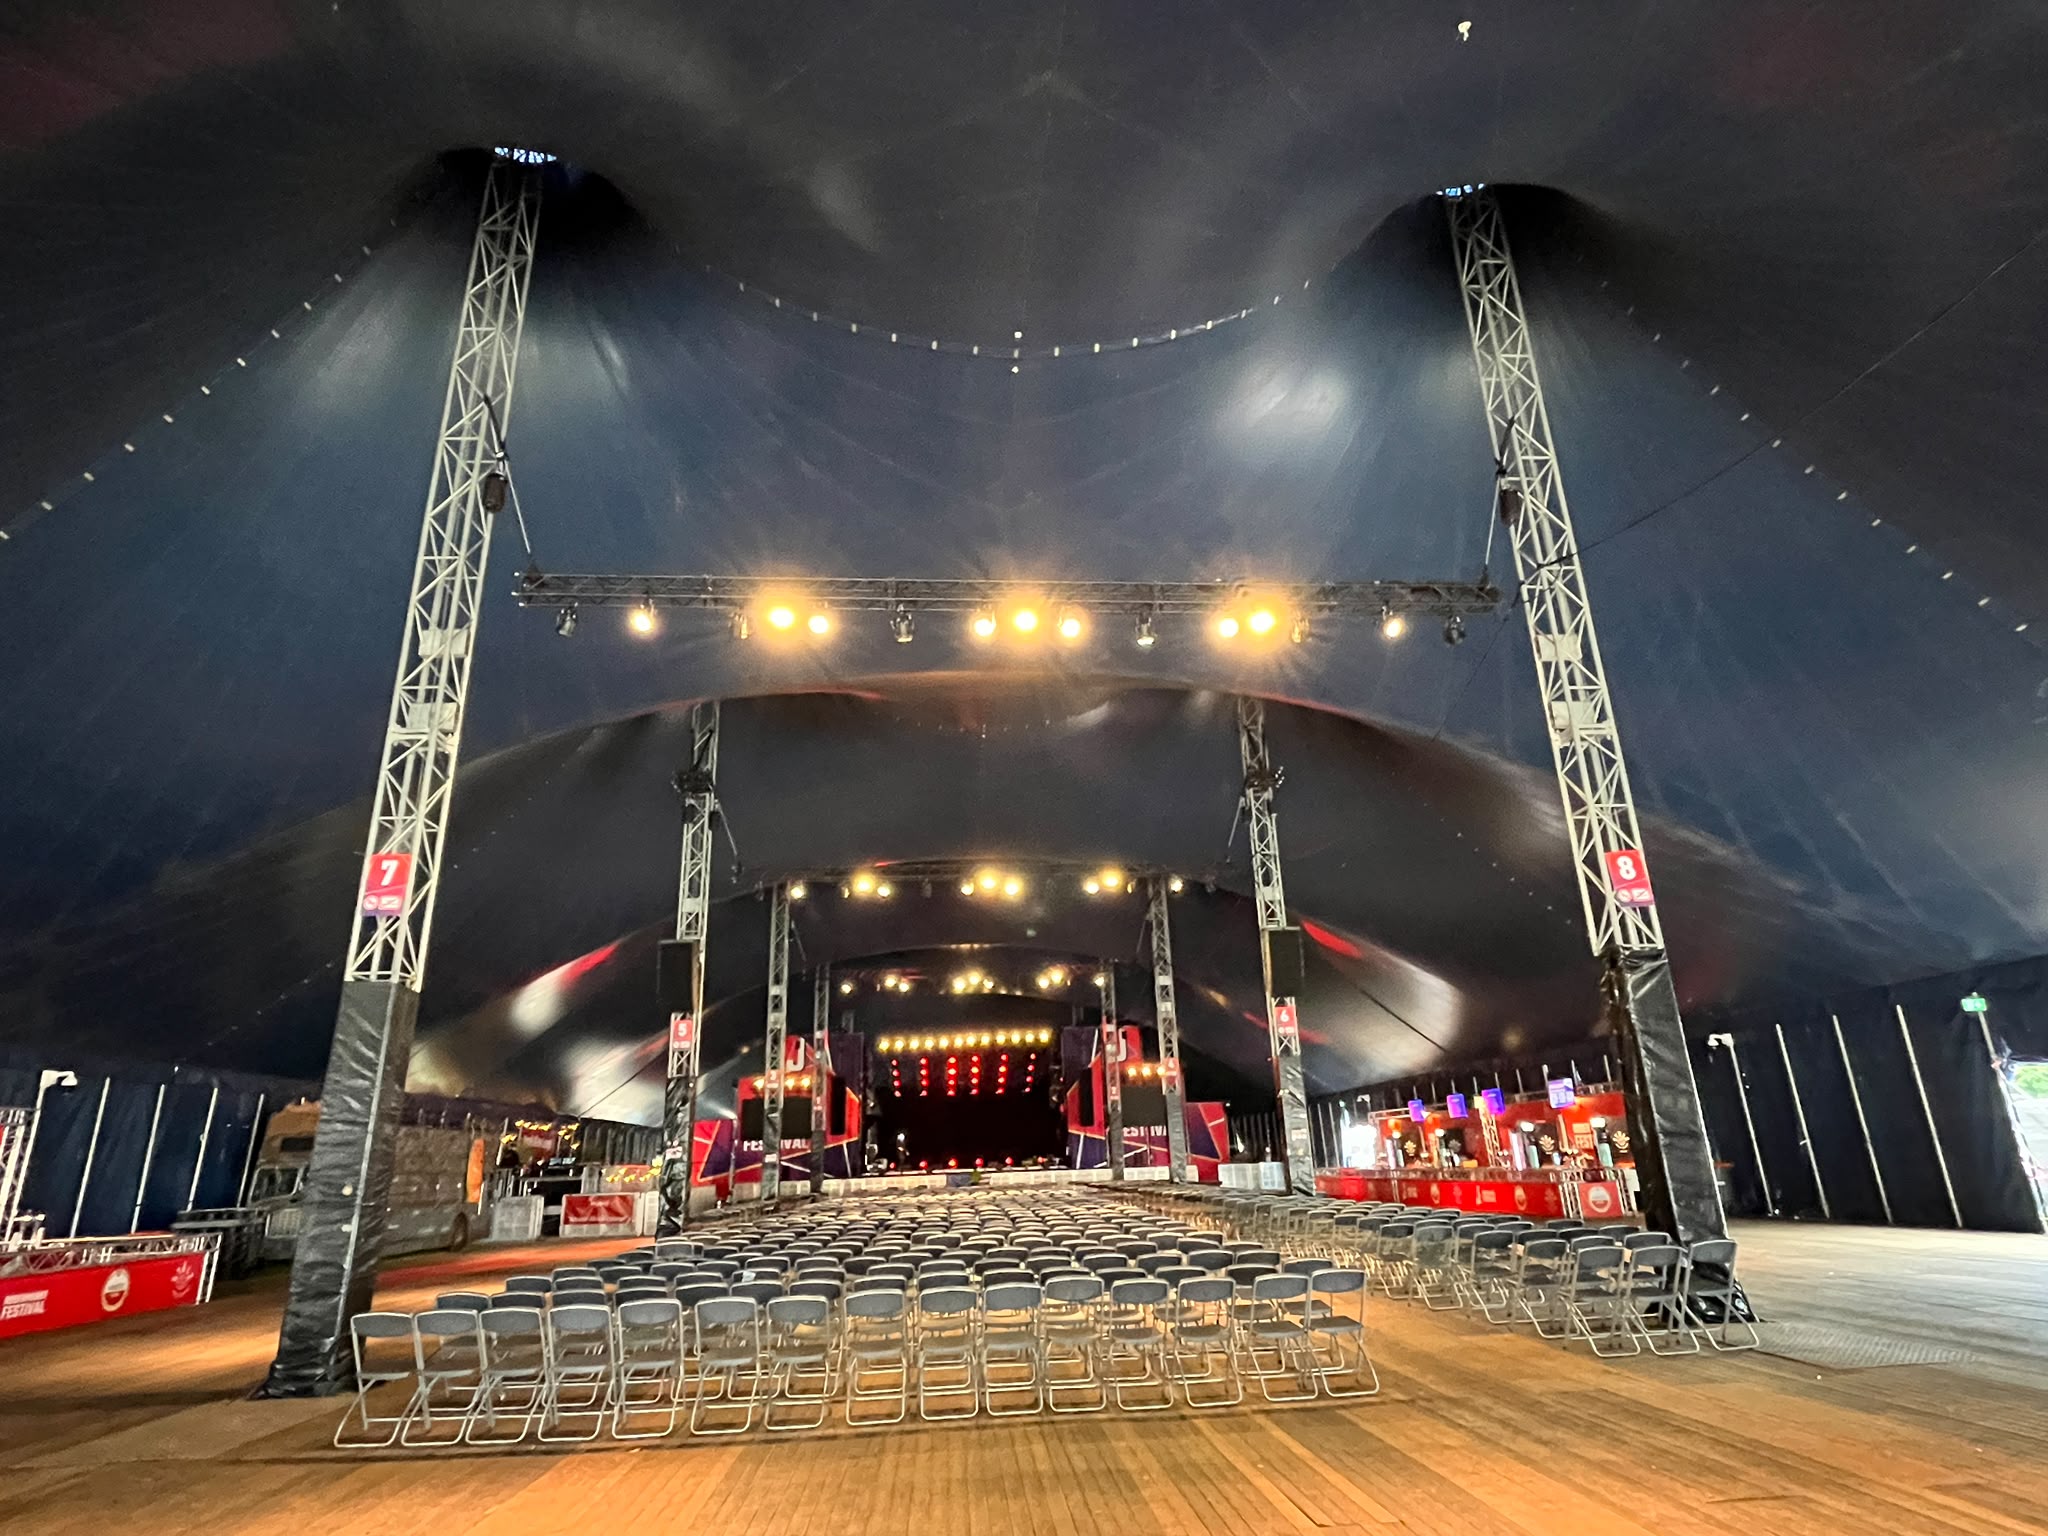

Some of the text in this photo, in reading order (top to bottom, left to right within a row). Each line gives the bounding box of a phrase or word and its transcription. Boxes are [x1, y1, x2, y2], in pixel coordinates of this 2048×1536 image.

[380, 859, 399, 886] 7
[1617, 855, 1637, 880] 8
[1280, 1009, 1290, 1022] 6
[678, 1023, 687, 1037] 5
[786, 1036, 805, 1071] J
